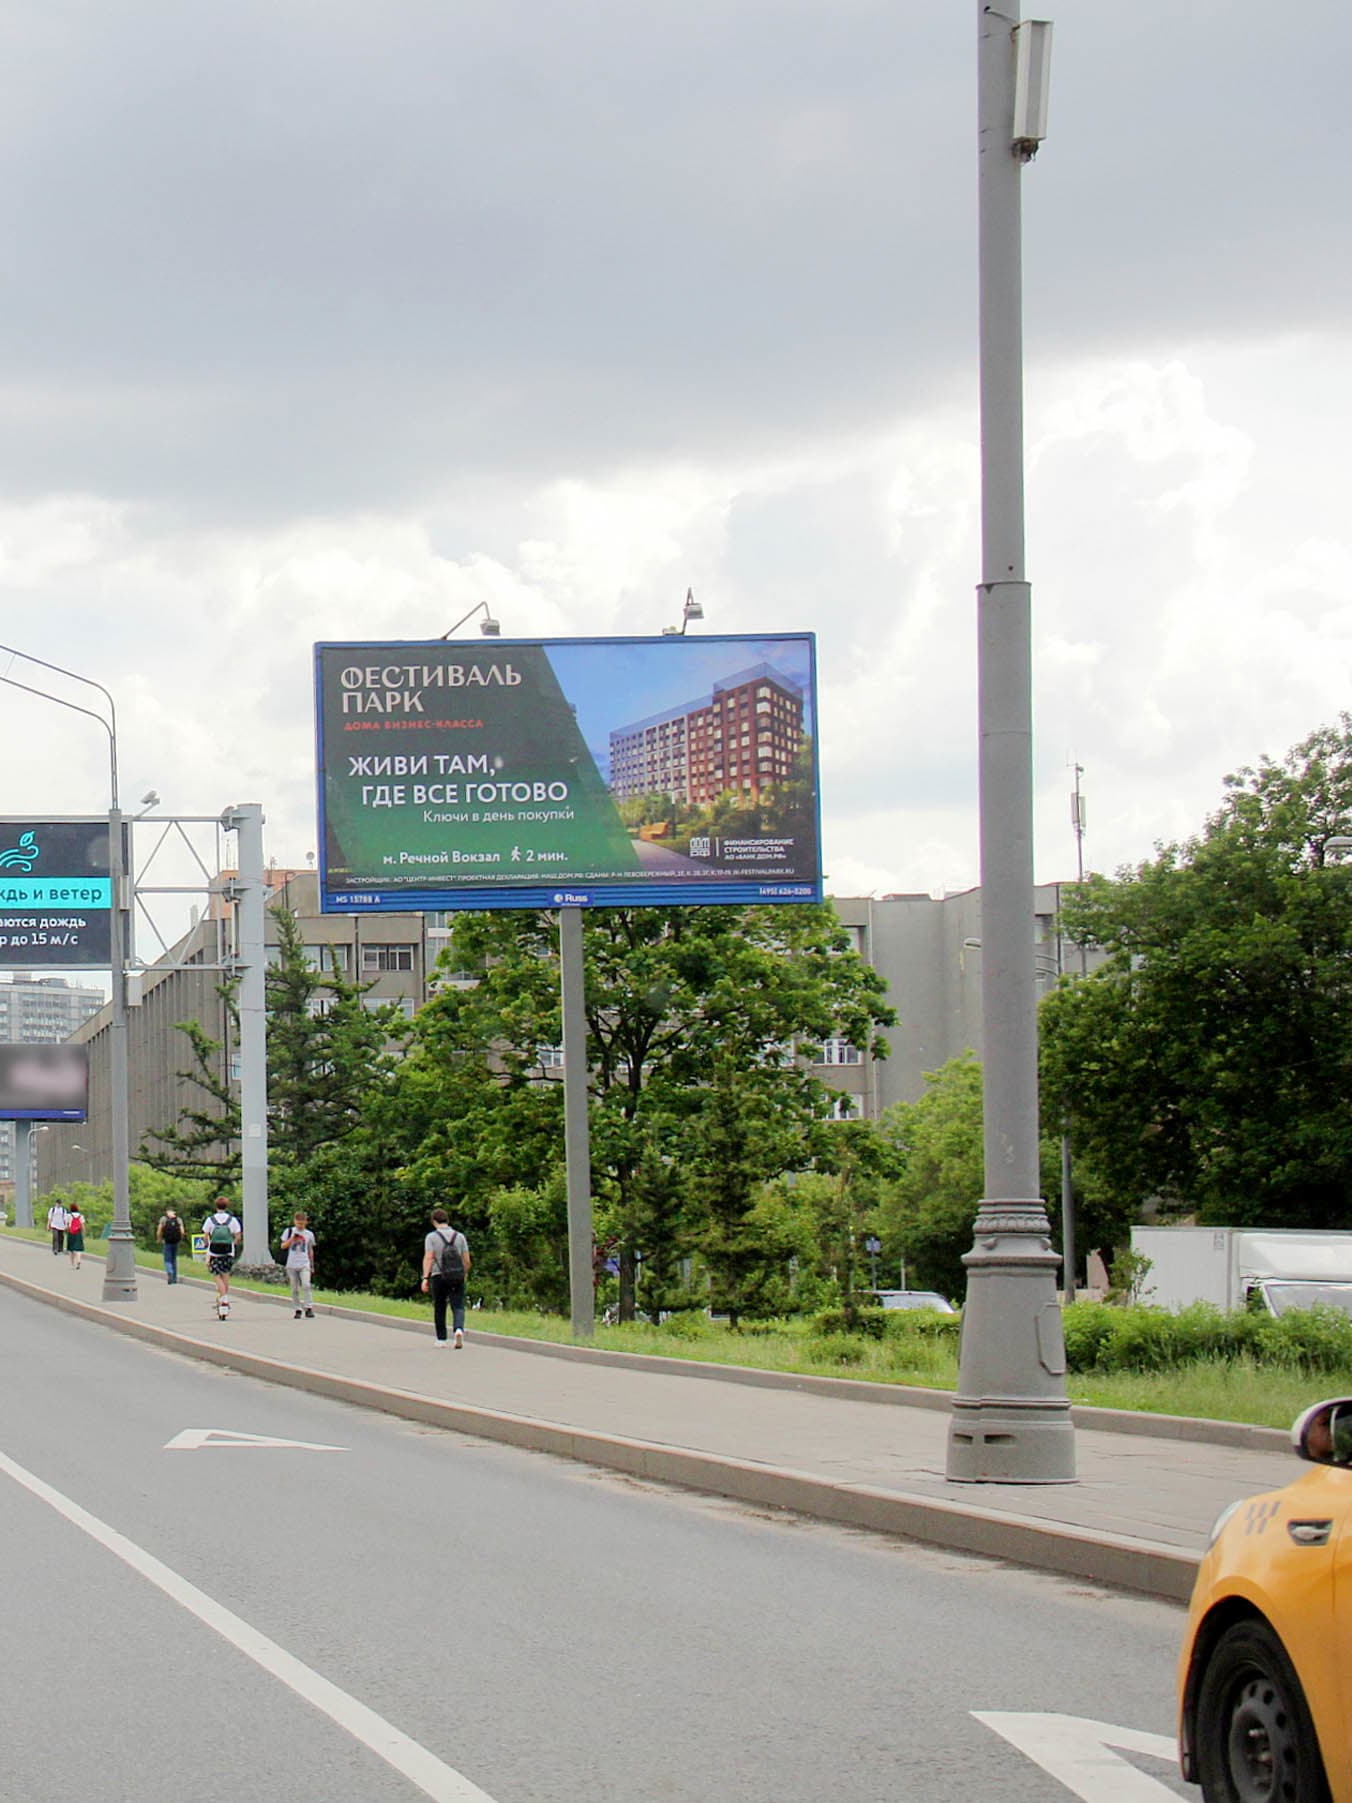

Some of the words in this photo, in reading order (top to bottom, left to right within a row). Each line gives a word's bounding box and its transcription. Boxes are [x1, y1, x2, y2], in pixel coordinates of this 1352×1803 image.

[340, 664, 522, 689] ФЕСТИВАЛЬ
[342, 690, 425, 713] ПАРК
[344, 721, 381, 731] ДОМА
[384, 719, 484, 730] БИЗНЕС-КЛАССА
[348, 755, 428, 777] ЖИВИ
[433, 754, 496, 777] ТАМ,
[362, 785, 406, 808] ГДЕ
[413, 783, 458, 804] ВСЕ
[465, 781, 568, 804] ГОТОВО
[423, 810, 469, 823] Ключи
[472, 812, 479, 822] в
[483, 811, 515, 823] день
[517, 809, 575, 824] покупки
[383, 855, 396, 865] м.
[399, 851, 449, 865] Речной
[452, 850, 500, 863] Вокзал
[526, 850, 535, 862] 2
[537, 852, 568, 862] мин.
[724, 846, 785, 855] СТРОИТЕЛЬСТВА
[33, 889, 43, 900] и
[49, 889, 102, 902] ветер
[564, 893, 588, 903] Russ
[39, 917, 86, 929] дождь
[10, 935, 28, 946] до
[31, 932, 47, 945] 15
[50, 933, 78, 946] м/с
